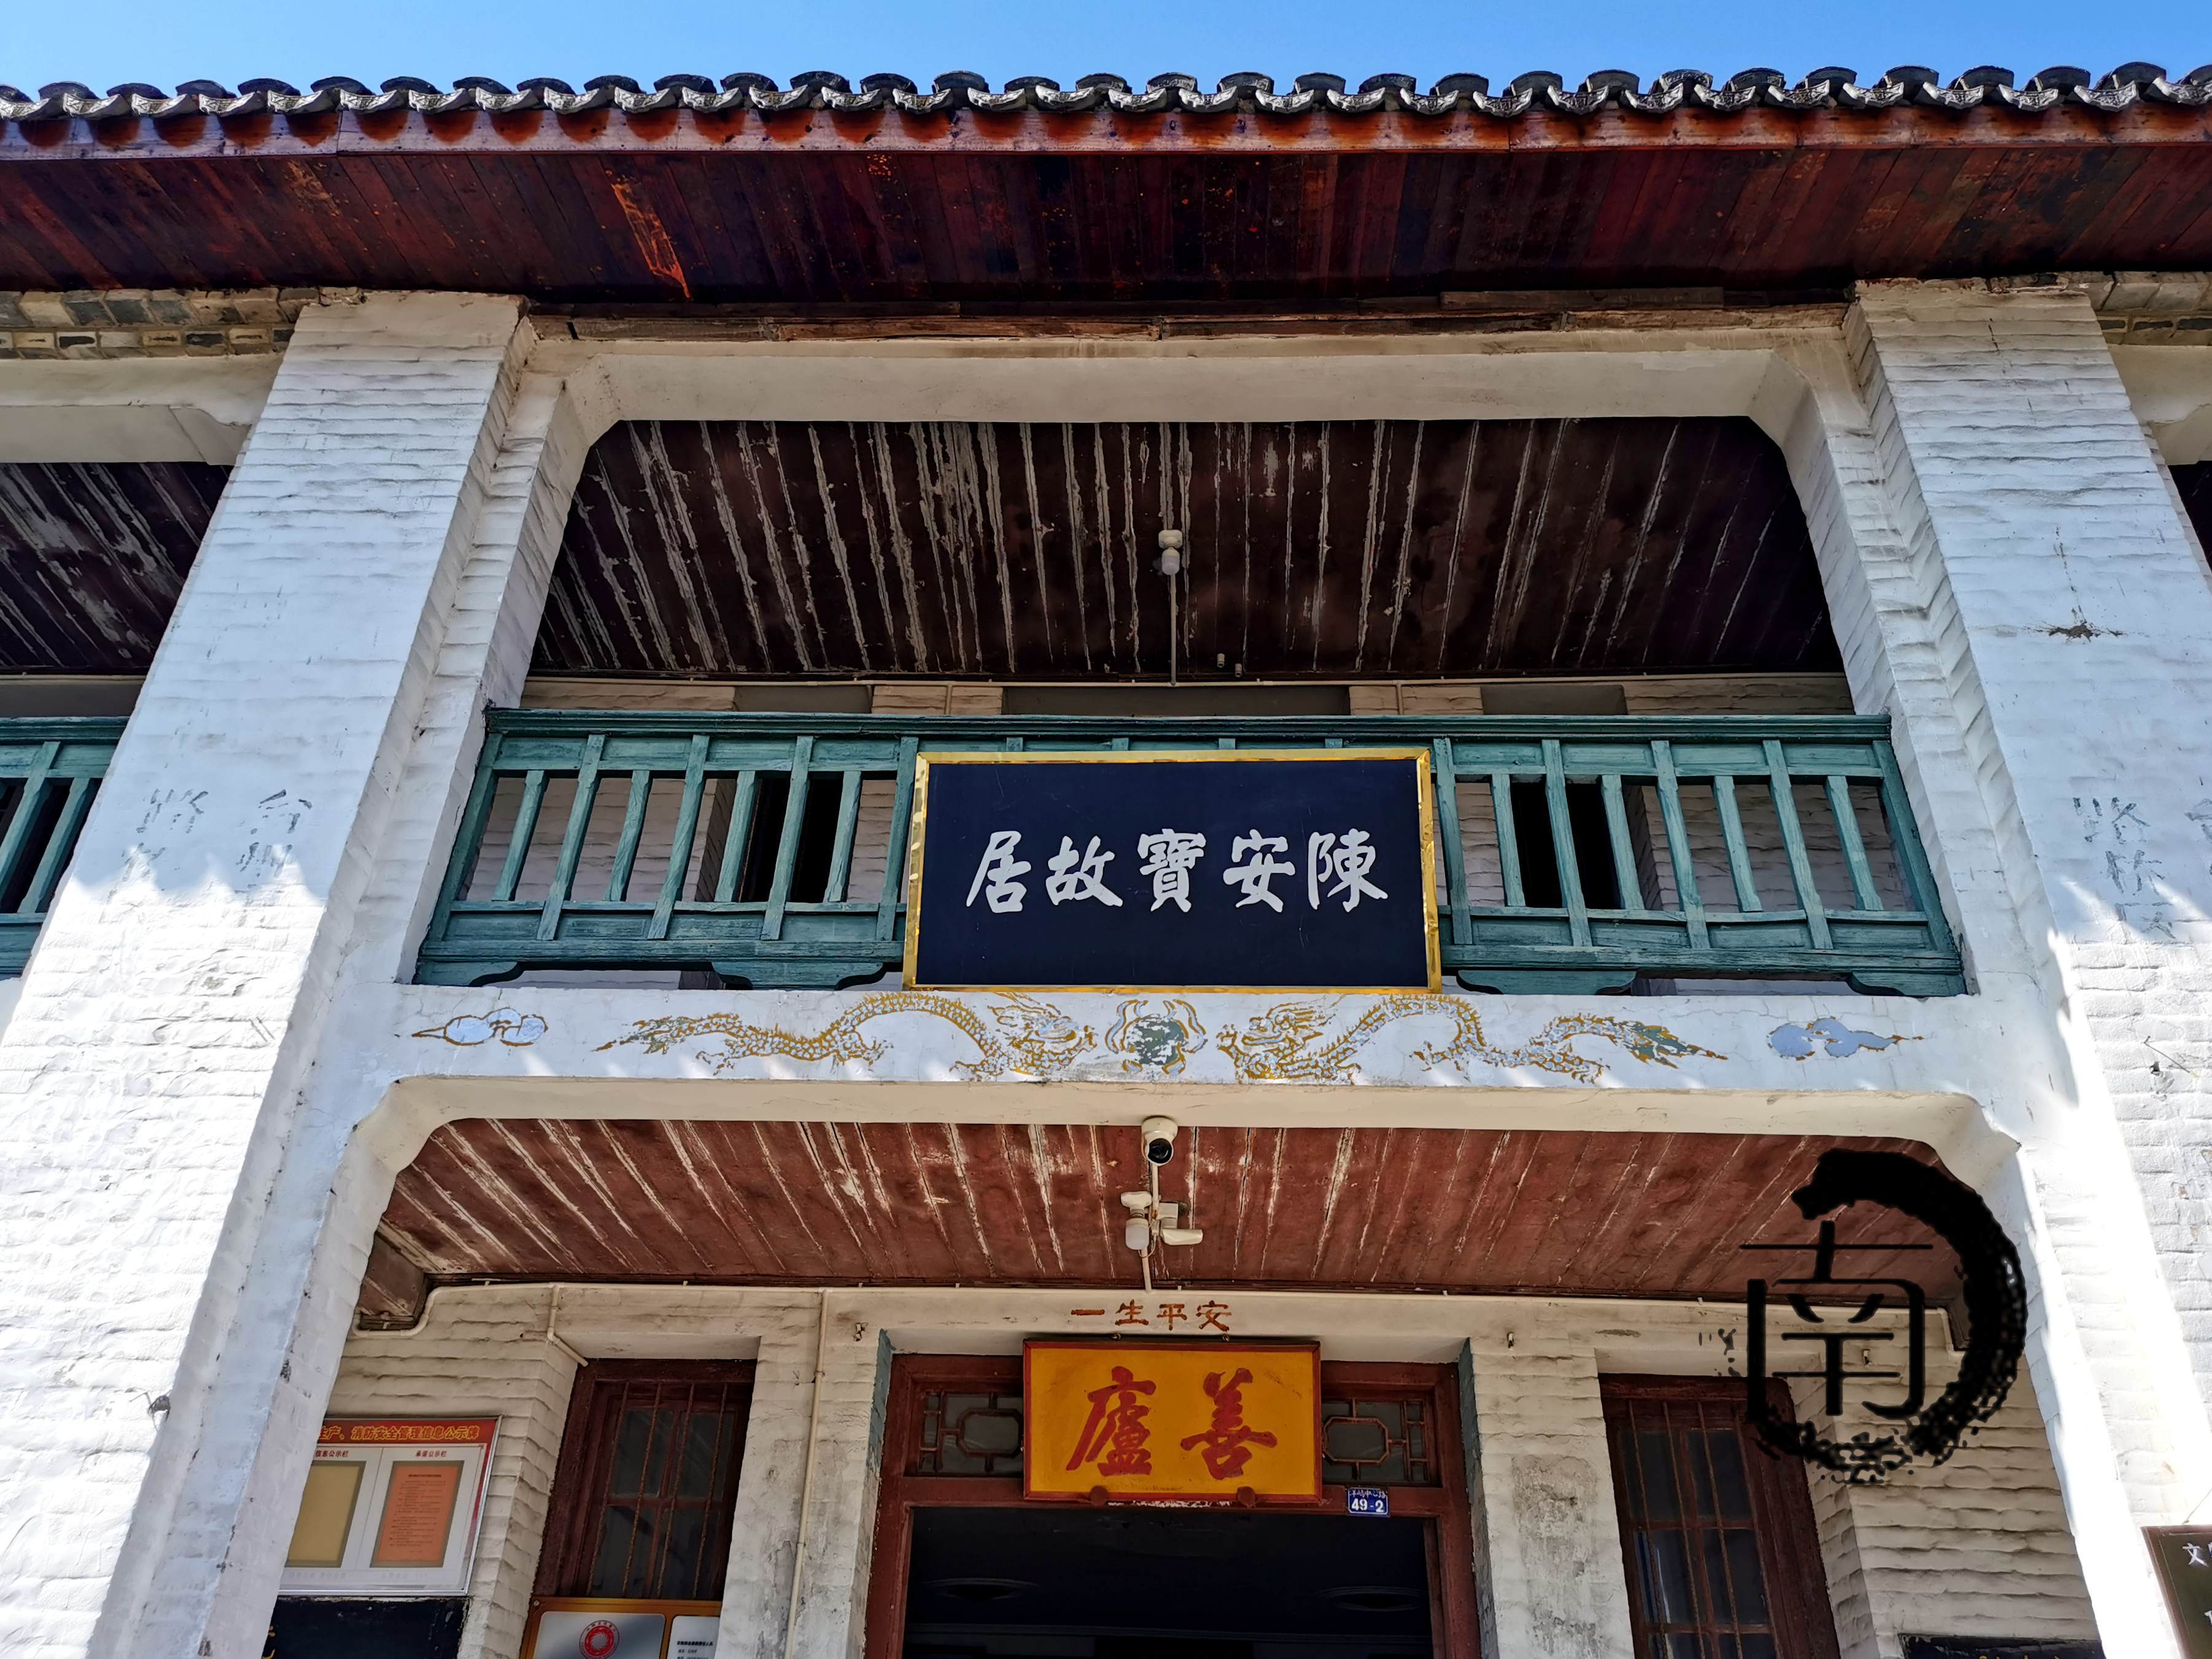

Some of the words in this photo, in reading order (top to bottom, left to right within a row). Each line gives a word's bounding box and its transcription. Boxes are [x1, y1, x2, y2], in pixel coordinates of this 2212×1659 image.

[966, 828, 1389, 914] 陳安寶故居
[1071, 1299, 1232, 1332] 一生平安
[1351, 1498, 1384, 1513] 49-2
[2181, 1542, 2212, 1568] 文
